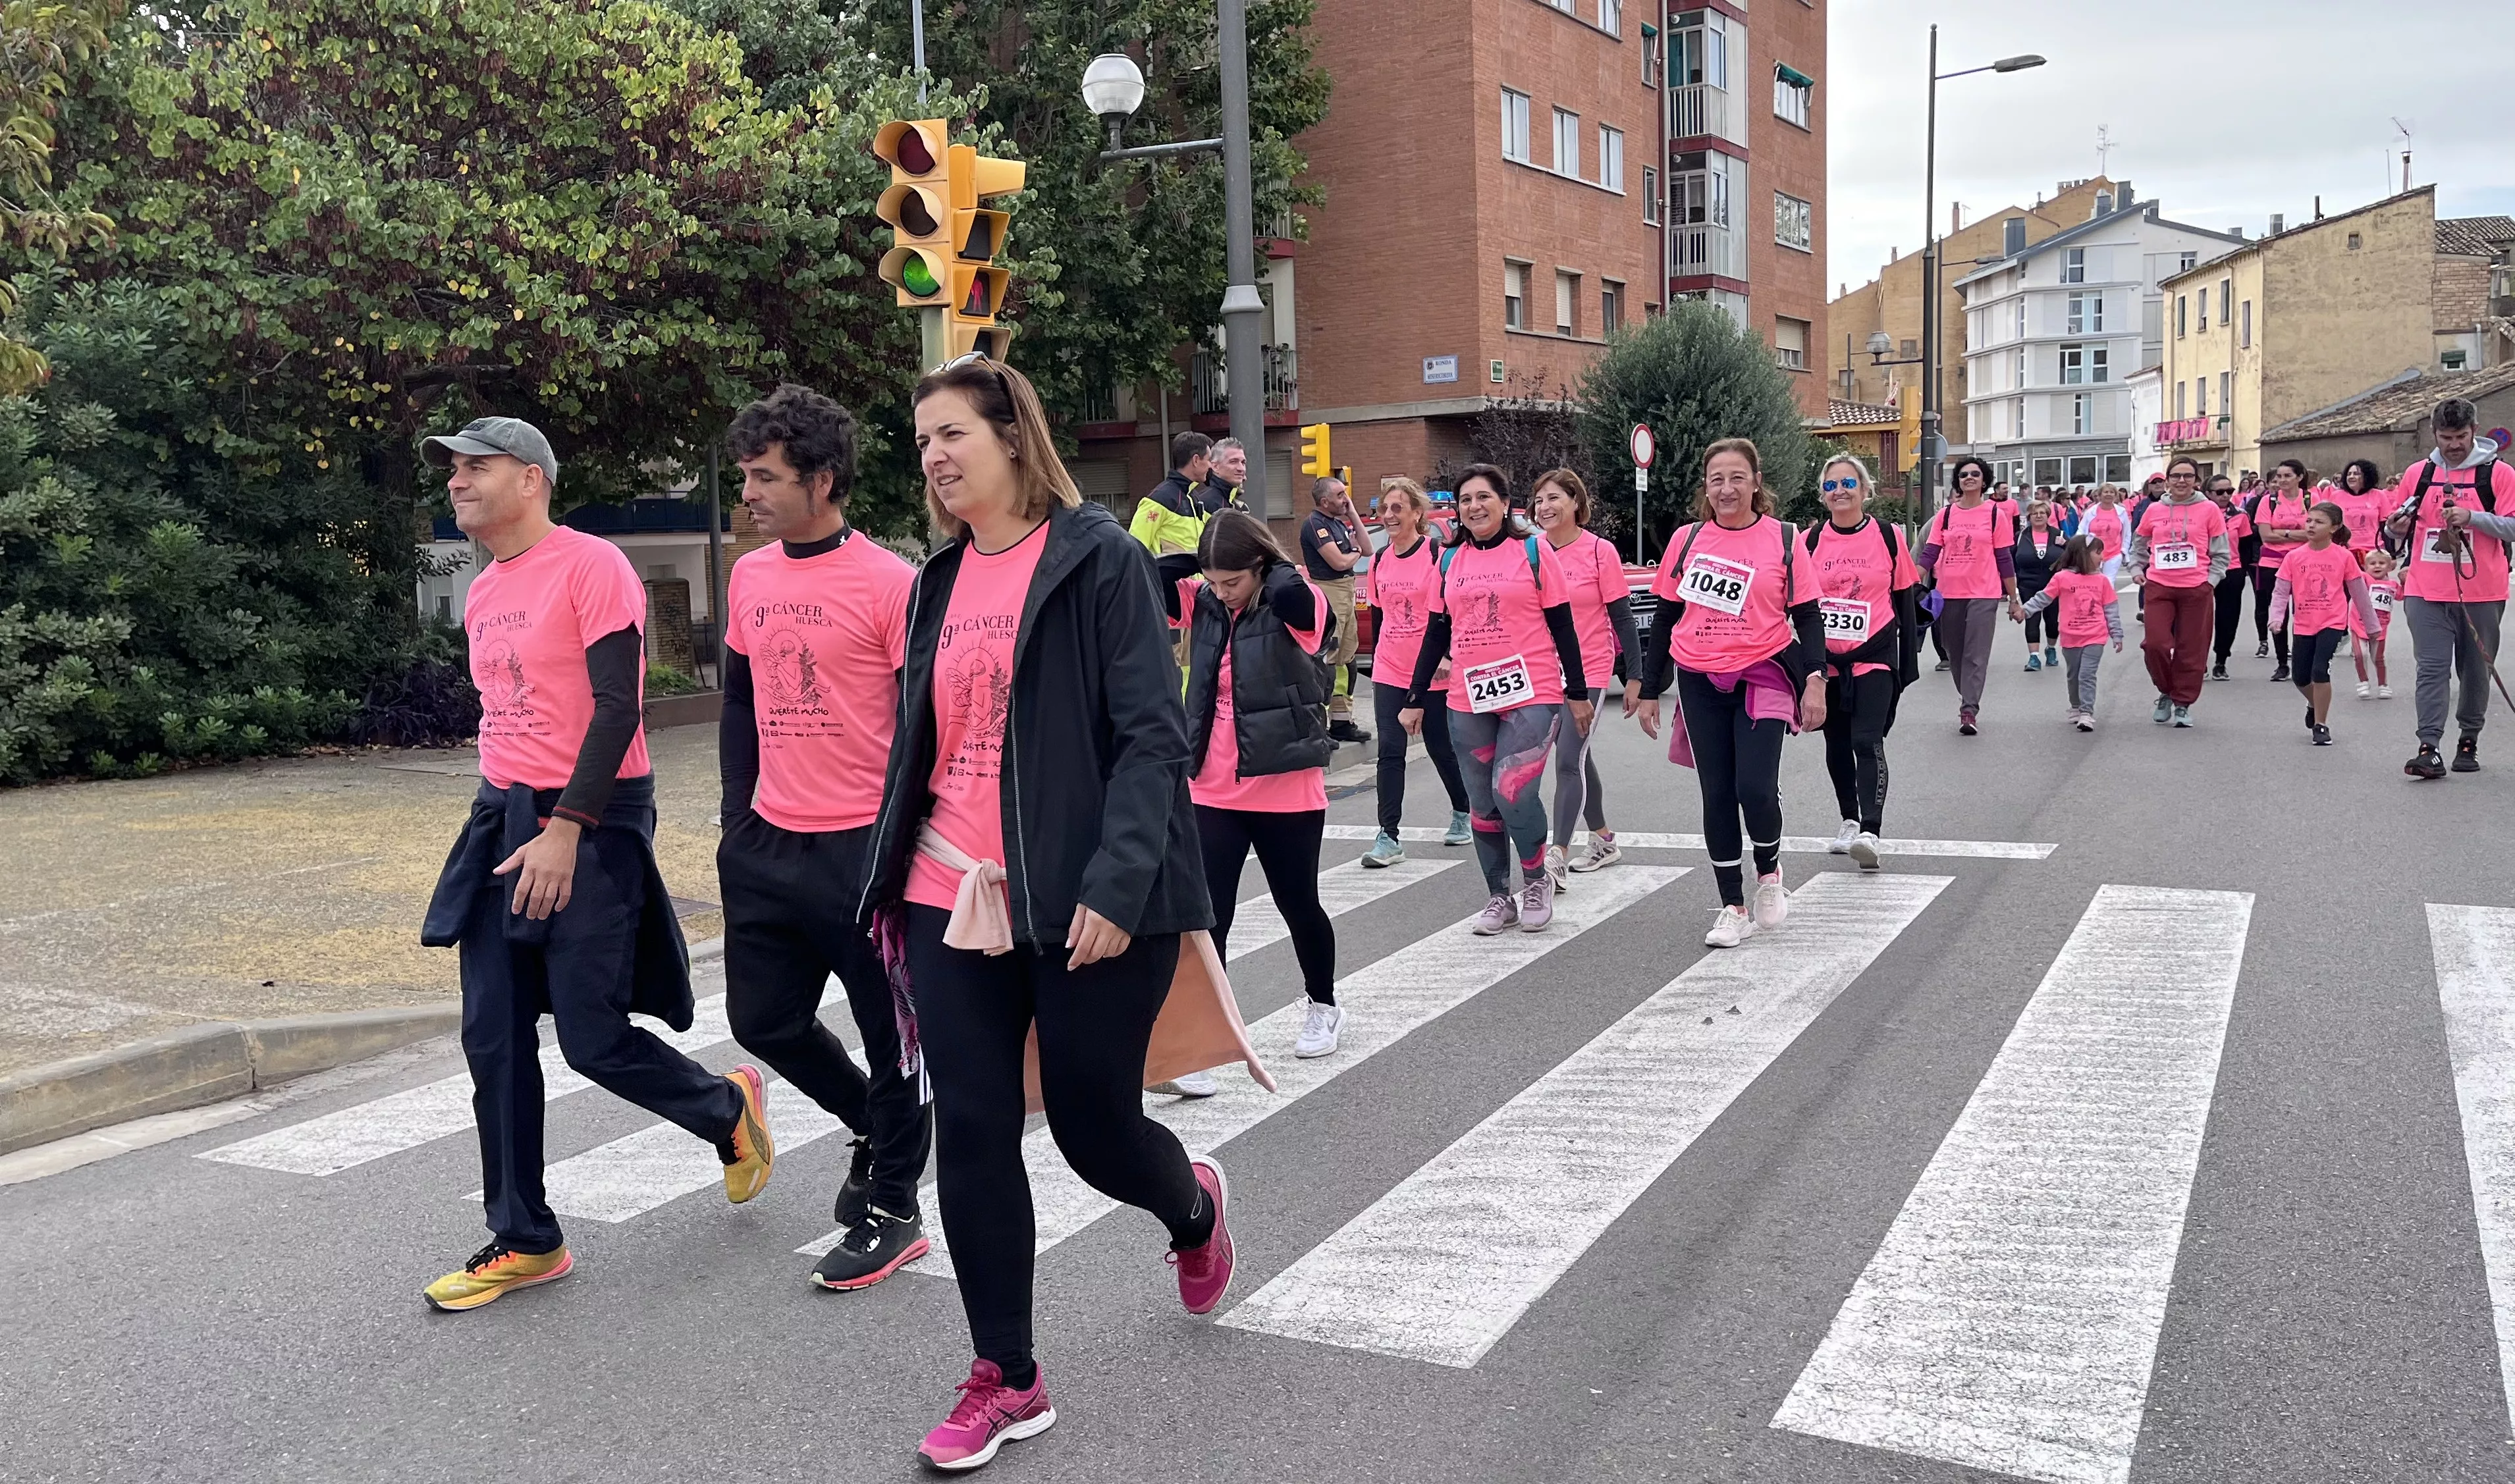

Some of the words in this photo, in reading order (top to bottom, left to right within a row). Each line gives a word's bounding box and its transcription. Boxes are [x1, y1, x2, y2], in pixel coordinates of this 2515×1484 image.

[2163, 552, 2188, 562] 483
[1690, 571, 1742, 600] 1048
[1357, 589, 1366, 597] 112
[489, 611, 526, 627] CÁNCER
[756, 606, 770, 627] 9ª
[772, 600, 822, 617] CÁNCER
[506, 622, 532, 632] HUESCA
[796, 616, 832, 627] HUESCA
[963, 614, 1014, 631] CÁNCER
[1821, 612, 1864, 630] 2330
[988, 630, 1018, 640] HUESC
[1470, 673, 1491, 681] CONTRA
[1498, 664, 1520, 675] CÁNCER
[1472, 672, 1525, 701] 2453
[510, 708, 534, 718] MUCHO
[801, 707, 829, 716] MUCHO
